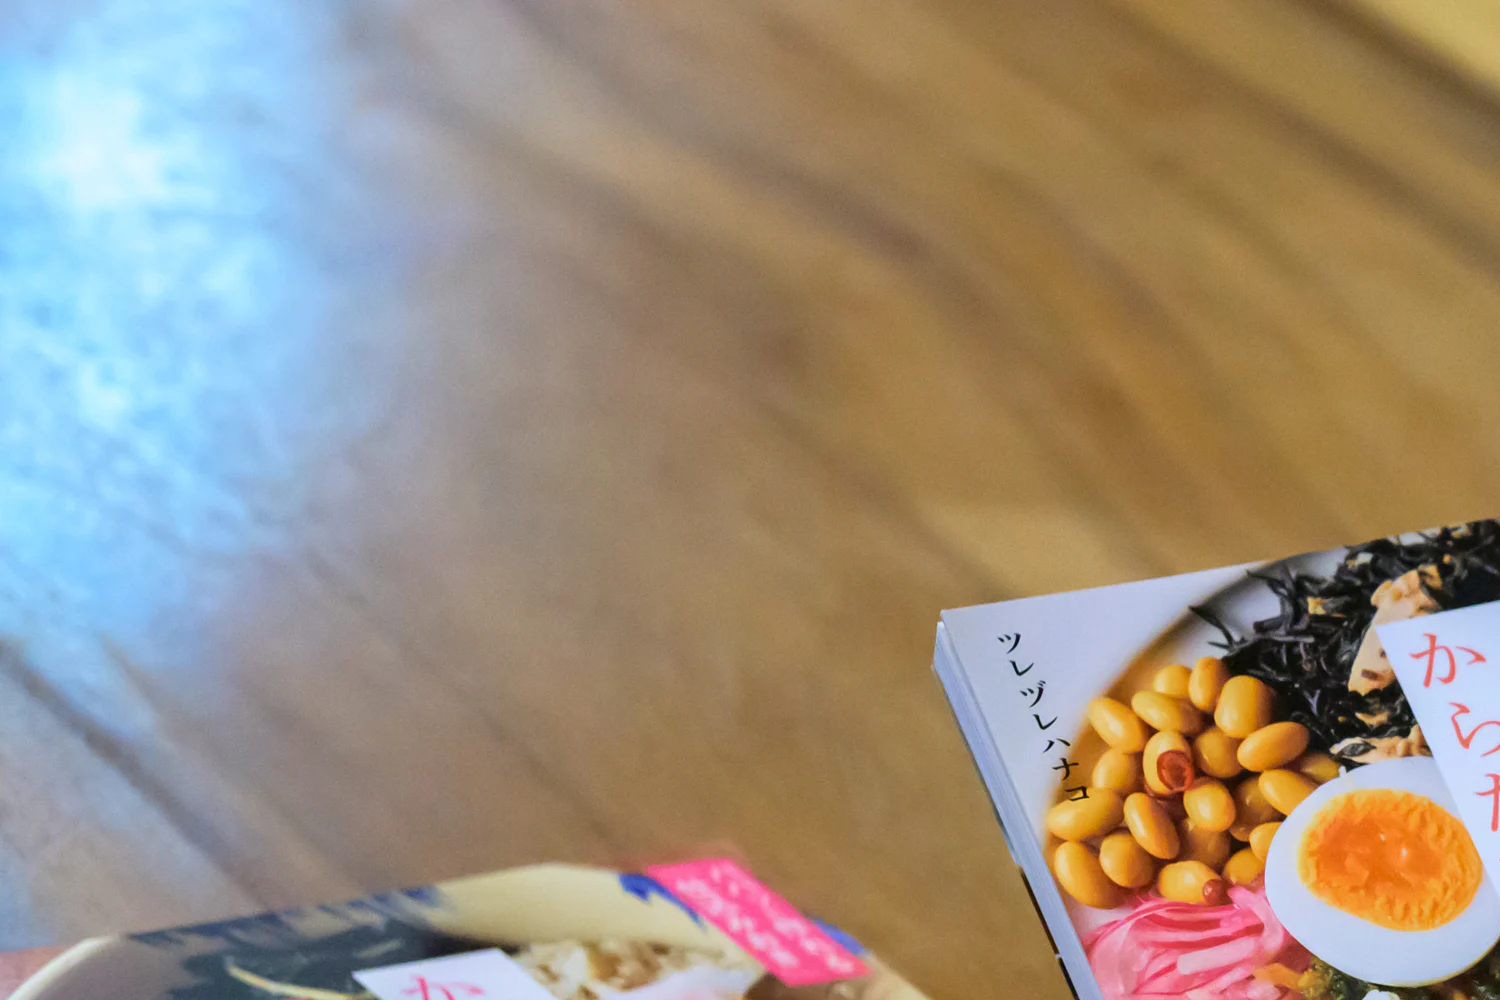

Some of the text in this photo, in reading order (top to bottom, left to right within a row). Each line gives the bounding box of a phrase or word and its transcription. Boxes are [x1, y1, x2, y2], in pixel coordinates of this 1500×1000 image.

[997, 632, 1089, 802] ツレヅレハナコ
